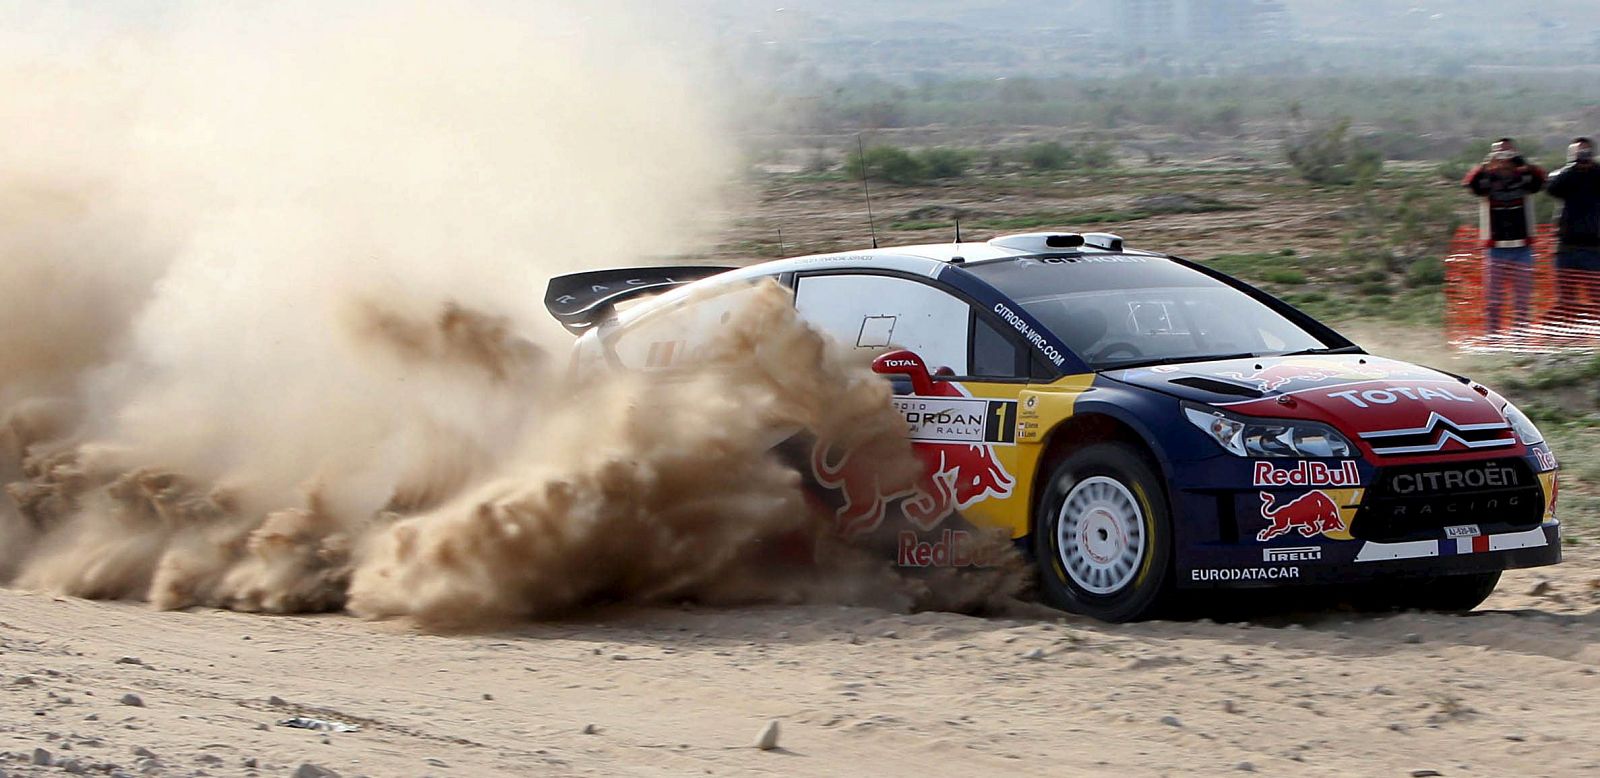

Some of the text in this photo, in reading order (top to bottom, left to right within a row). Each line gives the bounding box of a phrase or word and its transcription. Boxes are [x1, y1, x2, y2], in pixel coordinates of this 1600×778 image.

[994, 303, 1065, 367] CITROEN-WRC.COM
[884, 359, 918, 367] TOTAL
[1327, 387, 1475, 408] TOTAL
[906, 412, 982, 426] ORDAN
[995, 402, 1008, 442] 1
[936, 427, 980, 435] RALLY
[1253, 460, 1360, 486] Red Bull
[898, 529, 951, 567] Red
[1263, 546, 1321, 561] PIRELLI
[1191, 567, 1299, 581] EURODATACAR
